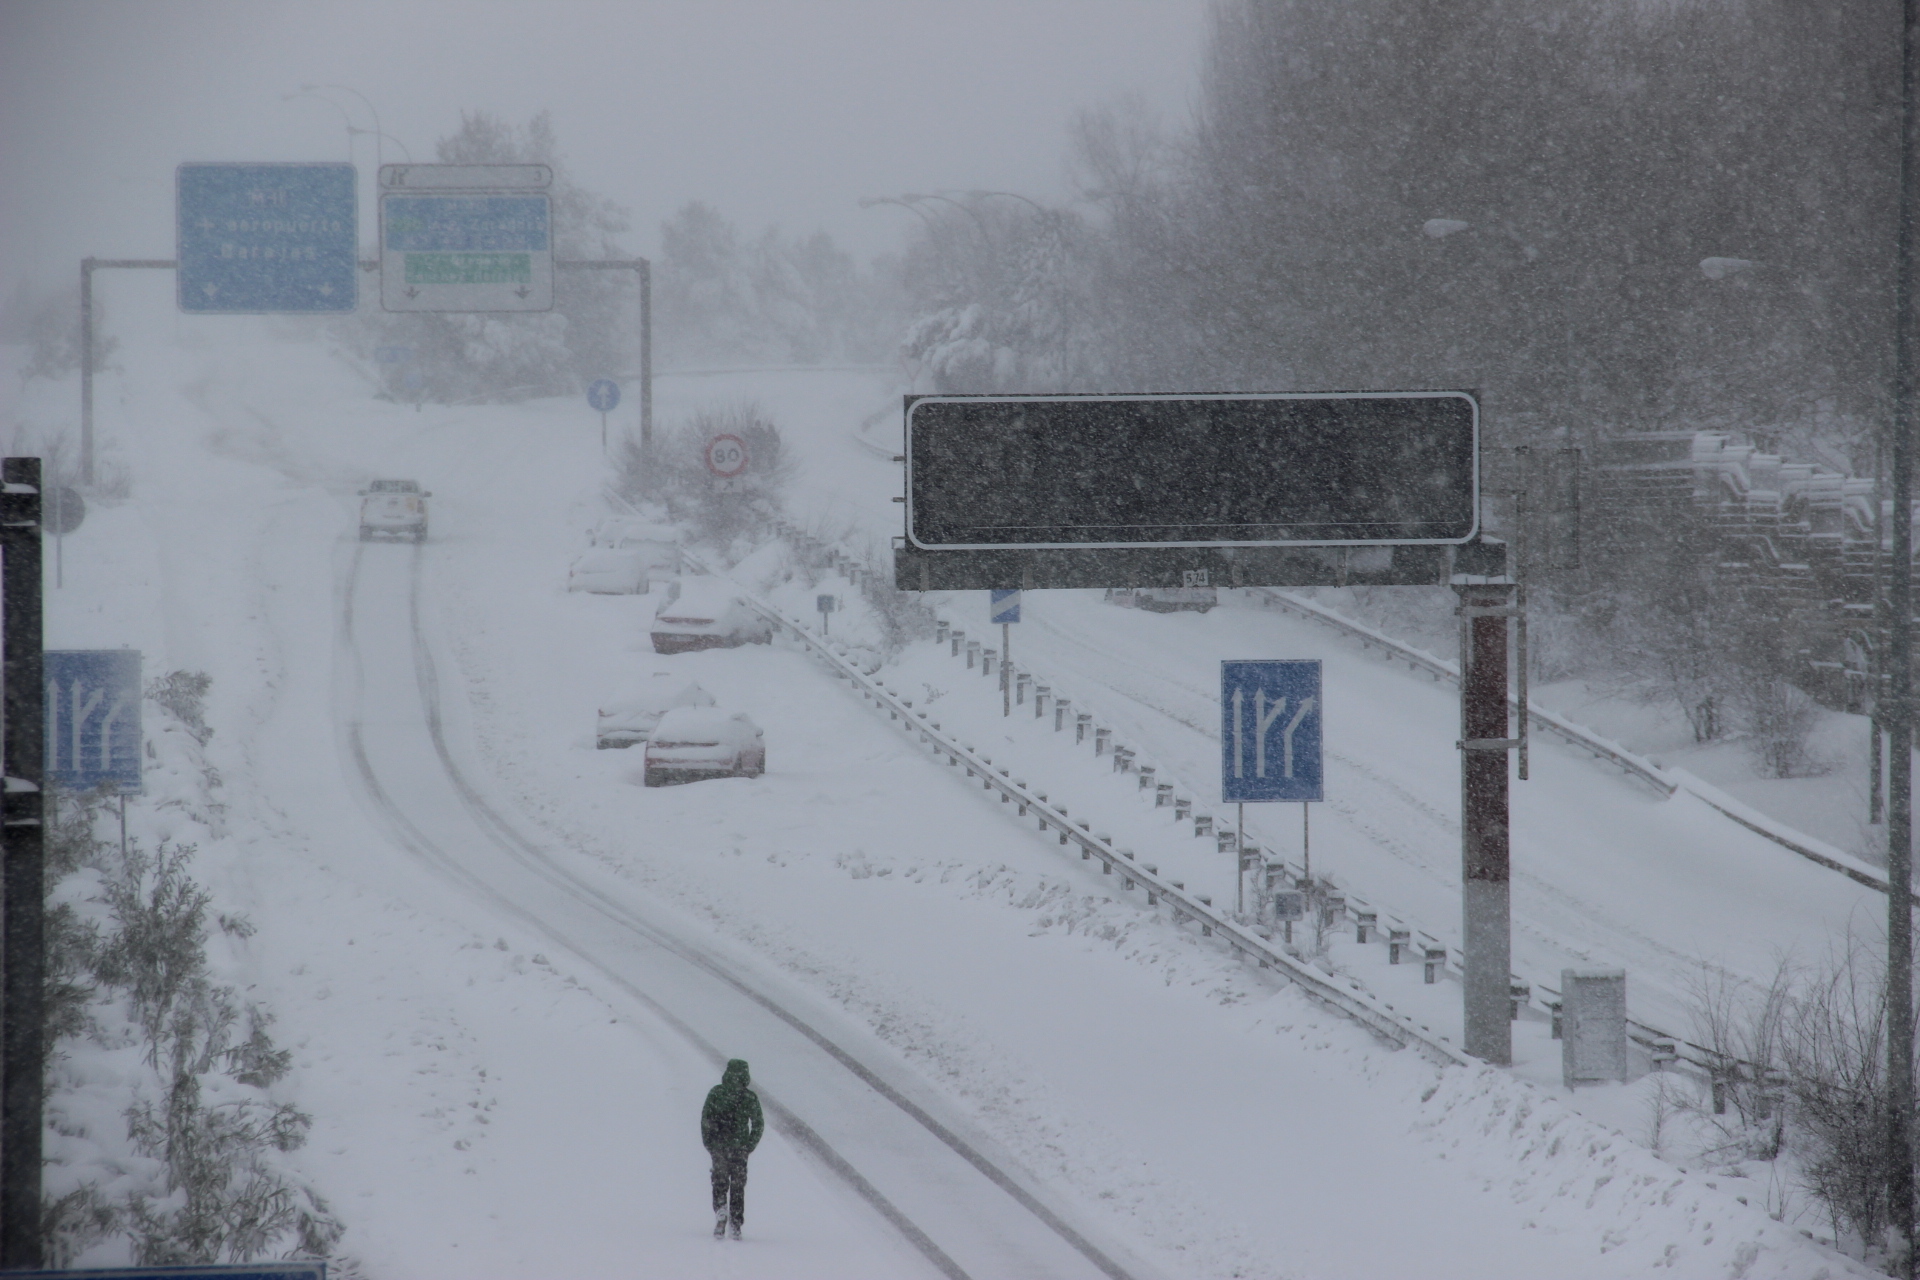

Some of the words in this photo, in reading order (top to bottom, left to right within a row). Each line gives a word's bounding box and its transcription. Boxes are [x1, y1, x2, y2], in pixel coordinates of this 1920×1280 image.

[533, 170, 543, 182] 3
[225, 219, 341, 234] aeropuerto
[221, 243, 317, 262] Barajas
[714, 448, 740, 464] 80
